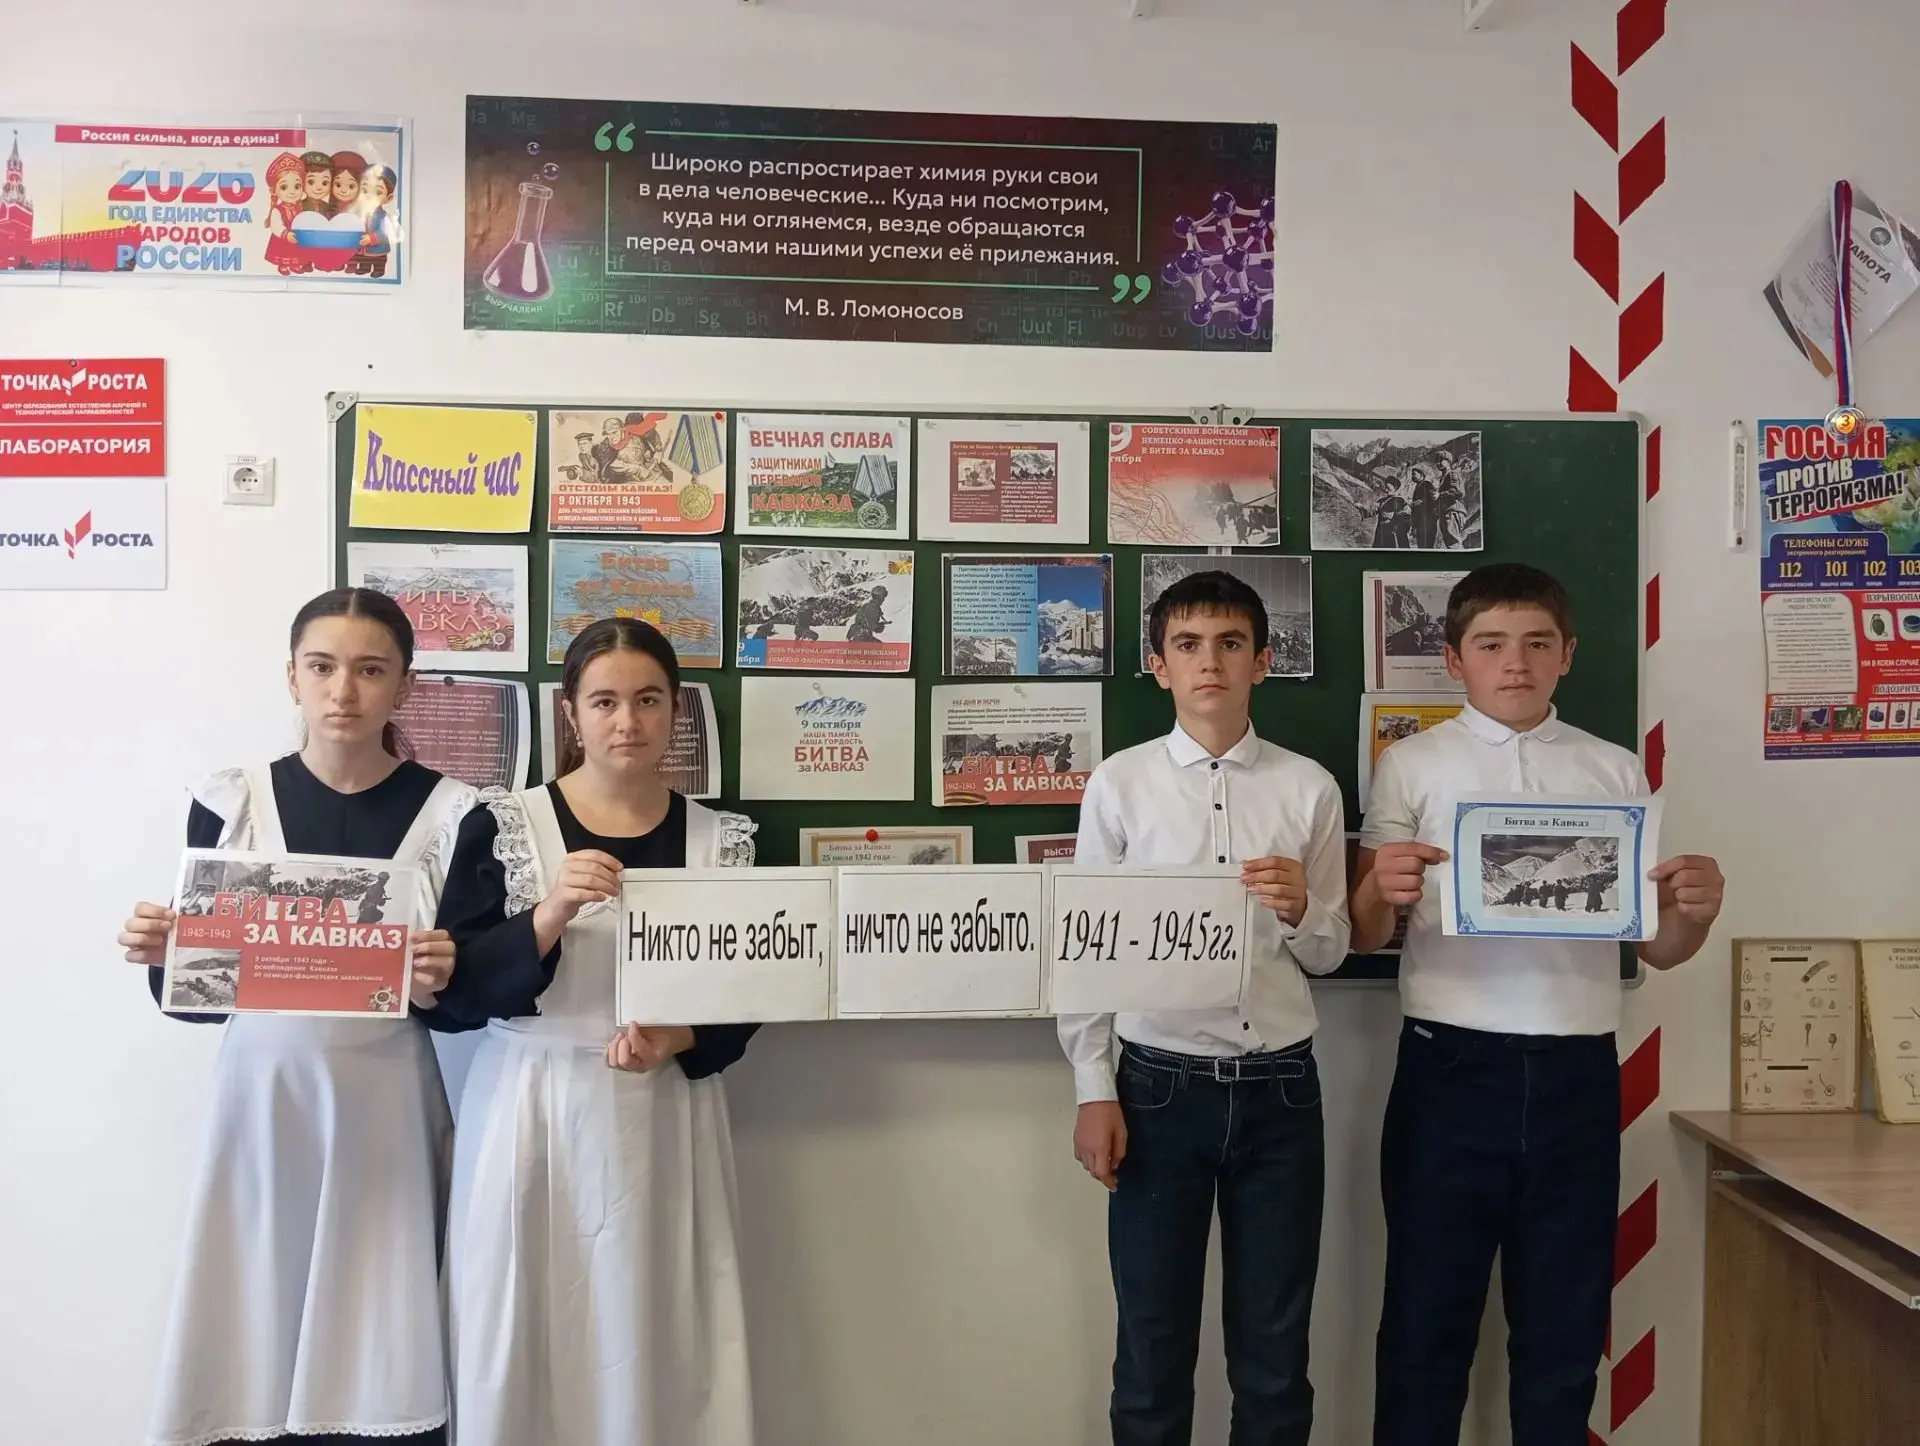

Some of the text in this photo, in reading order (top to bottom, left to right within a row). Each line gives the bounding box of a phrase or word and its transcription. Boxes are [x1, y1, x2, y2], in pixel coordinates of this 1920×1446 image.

[81, 129, 280, 146] Россия сильна, когда едина!
[651, 152, 1098, 187] Широко распростирает химия руки свои
[639, 183, 1109, 215] в дела человеческие... Куда ни посмотрим,
[108, 205, 252, 224] ГОД ЕДИНСТВА
[663, 210, 1085, 239] куда ни оглянемся, везде обращаются
[142, 226, 231, 245] АРОДОВ
[116, 244, 242, 271] РОССИИ
[626, 235, 1120, 266] перед очами нашими успехи её прилежания.
[604, 301, 624, 317] Rf
[652, 307, 676, 323] Db
[698, 310, 721, 328] Sg
[785, 297, 963, 320] М. В. Ломоносов
[1, 374, 147, 391] ТОЧКА РОСТА
[1841, 415, 1850, 427] 3
[750, 431, 893, 448] ВЕЧНАЯ СЛАВА
[1142, 427, 1248, 436] СОВЕТСКИМИ ВОЙСКАМИ
[0, 439, 150, 454] ЛАБОРАТОРИЯ
[1142, 437, 1276, 447] НЕМЕЦКО-ФАШИСТСКИХ ВОЙСК
[1765, 425, 1886, 460] РОССИЯ
[1149, 447, 1177, 455] БИТВЕ
[1192, 448, 1225, 456] КАВКАЗ
[363, 429, 522, 496] Классный час
[750, 457, 821, 470] ЗАЩИТНИКАМ
[1776, 458, 1853, 494] ПРОТИВ
[559, 484, 673, 493] ОТСТОИМ КАВКАЗ!
[1768, 472, 1903, 521] ТЕРРОРИЗМА!
[559, 496, 641, 505] 9 ОКТЯБРЯ 1943
[752, 493, 854, 512] КАВКАЗА
[0, 534, 153, 547] ТОЧКА РОСТА
[1784, 538, 1868, 548] ТЕЛЕФОНЫ СЛУЖБ
[1779, 562, 1802, 577] 112
[1825, 561, 1848, 577] 101
[1863, 561, 1886, 576] 102
[400, 590, 495, 605] ИТВА
[1867, 593, 1920, 602] ВЗРЫВООПА
[423, 604, 452, 613] ЗА
[1873, 684, 1920, 693] ПОДОЗРИТЕ
[801, 720, 861, 731] 9 октября
[794, 746, 869, 762] БИТВА
[798, 762, 864, 772] за КАВКАЗ
[961, 755, 1051, 776] БИТВА
[984, 776, 1086, 792] ЗА КАВКАЗ
[1504, 817, 1589, 828] Битва за Кавказ
[1044, 848, 1076, 857] ВЫСТР
[213, 892, 350, 924] БИТВА
[846, 897, 1035, 954] ничто не забыто.
[243, 924, 402, 949] ЗА КАВКАЗ
[628, 909, 823, 968] Никто не забыт,
[1058, 909, 1121, 962] 1941
[1148, 910, 1237, 962] 1945гг.
